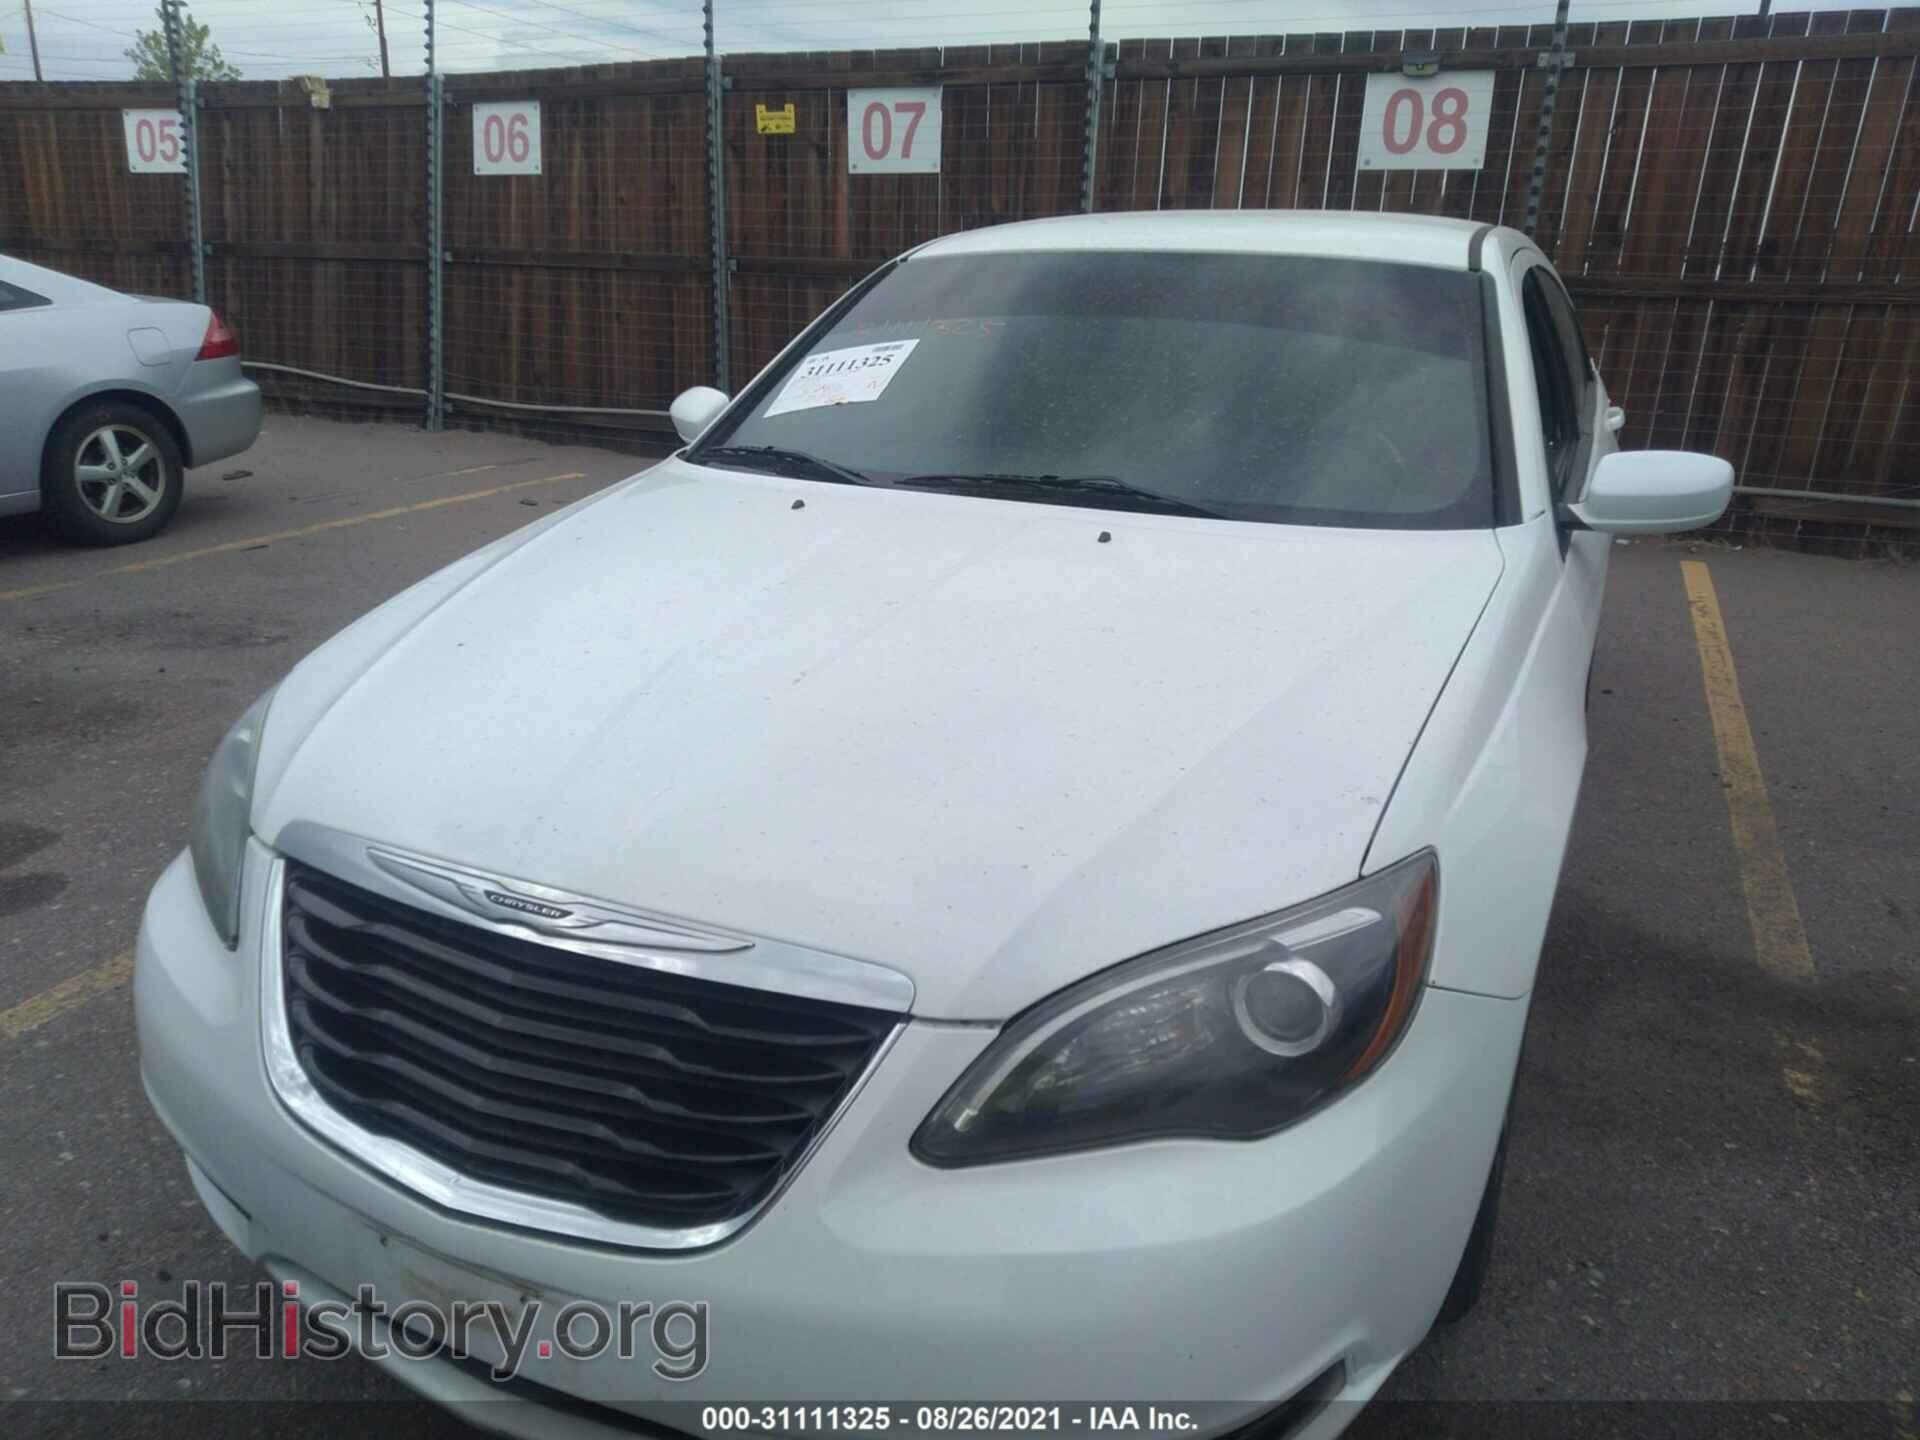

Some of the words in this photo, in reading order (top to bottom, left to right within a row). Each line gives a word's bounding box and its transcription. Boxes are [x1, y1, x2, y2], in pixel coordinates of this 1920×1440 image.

[135, 118, 179, 162] 05
[483, 114, 530, 163] 06
[861, 102, 926, 160] 07
[1382, 88, 1469, 155] 08
